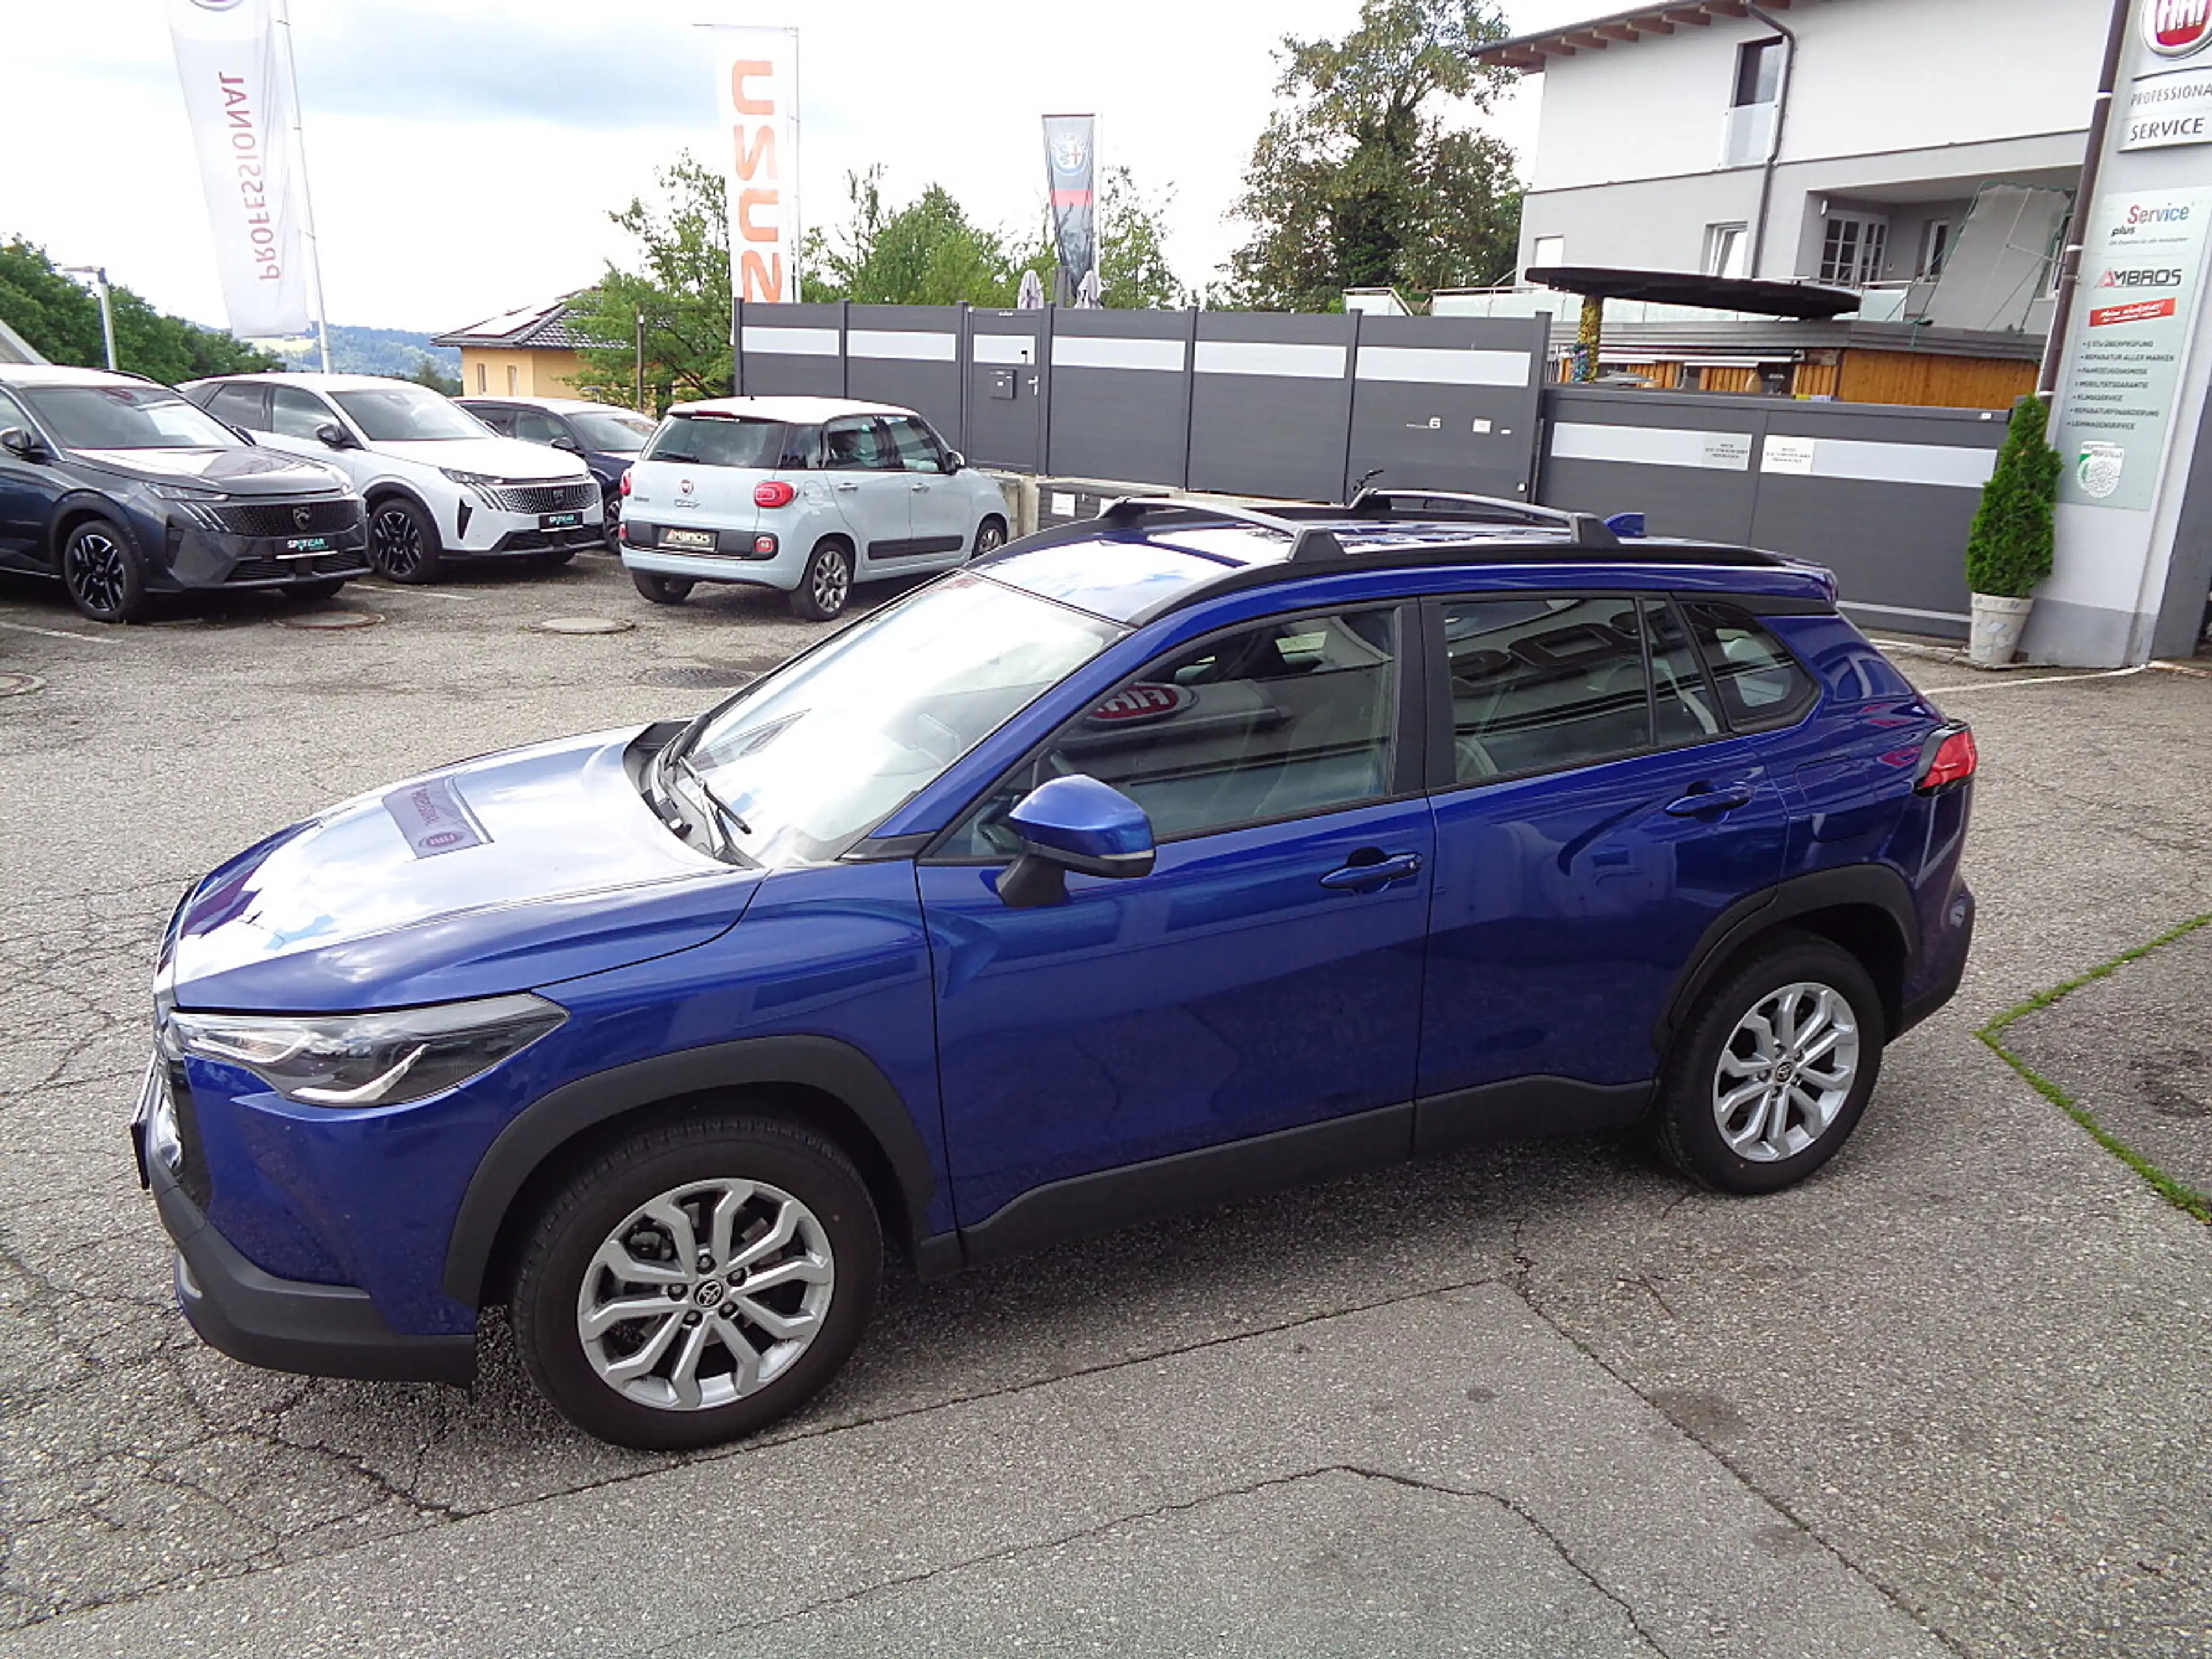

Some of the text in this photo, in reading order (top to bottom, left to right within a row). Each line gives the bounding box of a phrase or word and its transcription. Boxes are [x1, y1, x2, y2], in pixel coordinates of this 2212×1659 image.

[2130, 116, 2205, 141] SERVICE
[2127, 203, 2189, 224] Service
[2111, 225, 2135, 237] plus
[2094, 268, 2182, 287] AMBROS
